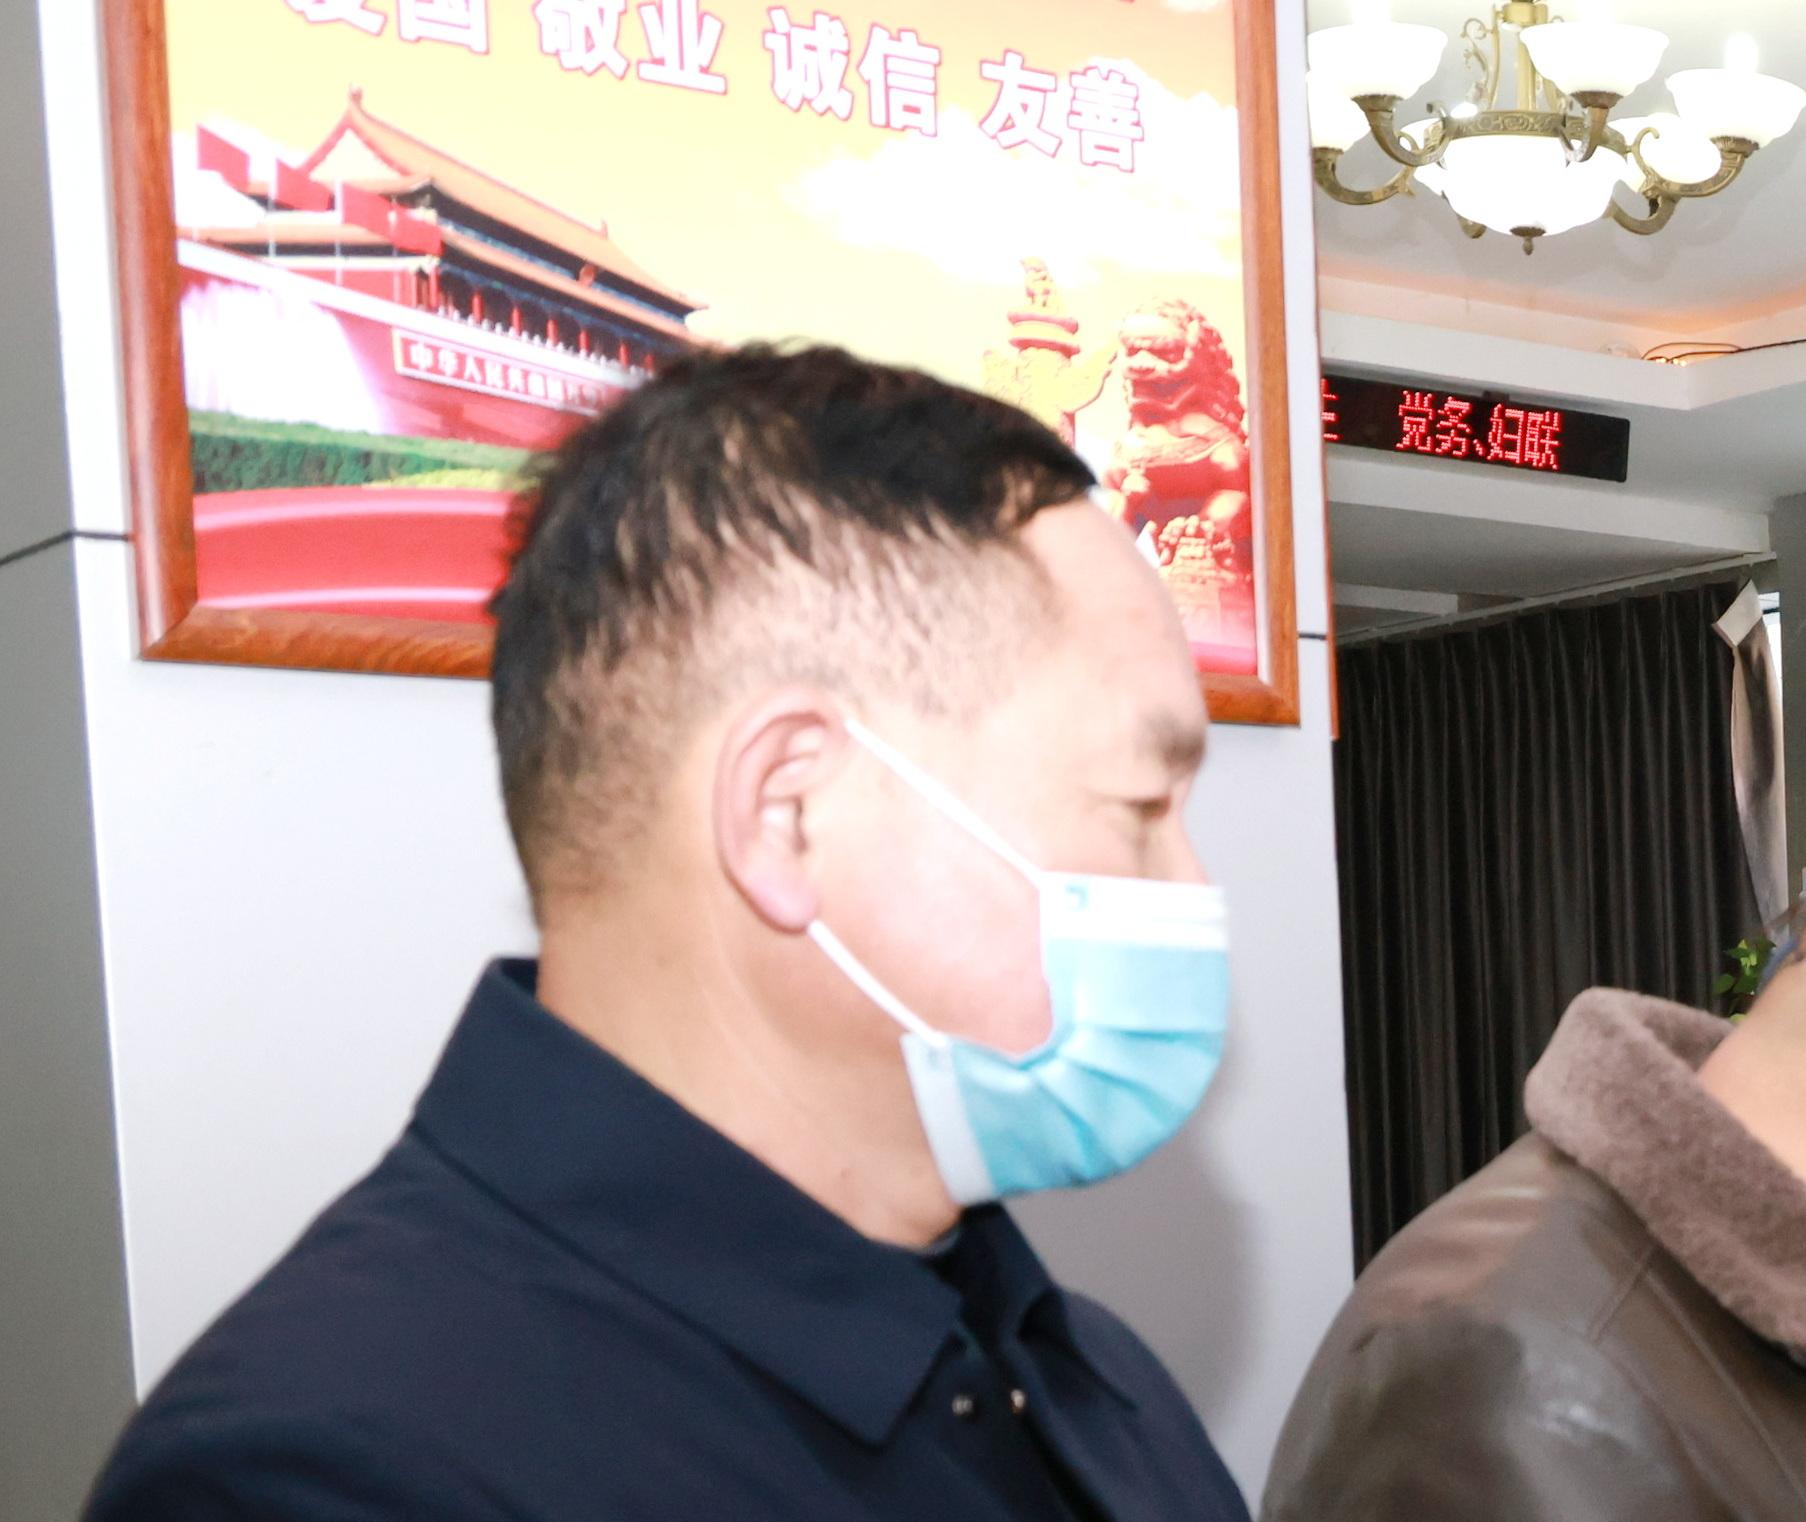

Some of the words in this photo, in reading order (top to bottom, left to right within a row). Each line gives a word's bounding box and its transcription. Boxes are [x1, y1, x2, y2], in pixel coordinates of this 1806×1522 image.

[532, 0, 728, 96] 敬业
[763, 5, 942, 137] 诚信
[979, 47, 1145, 174] 友善
[1395, 390, 1561, 471] 党务、妇联
